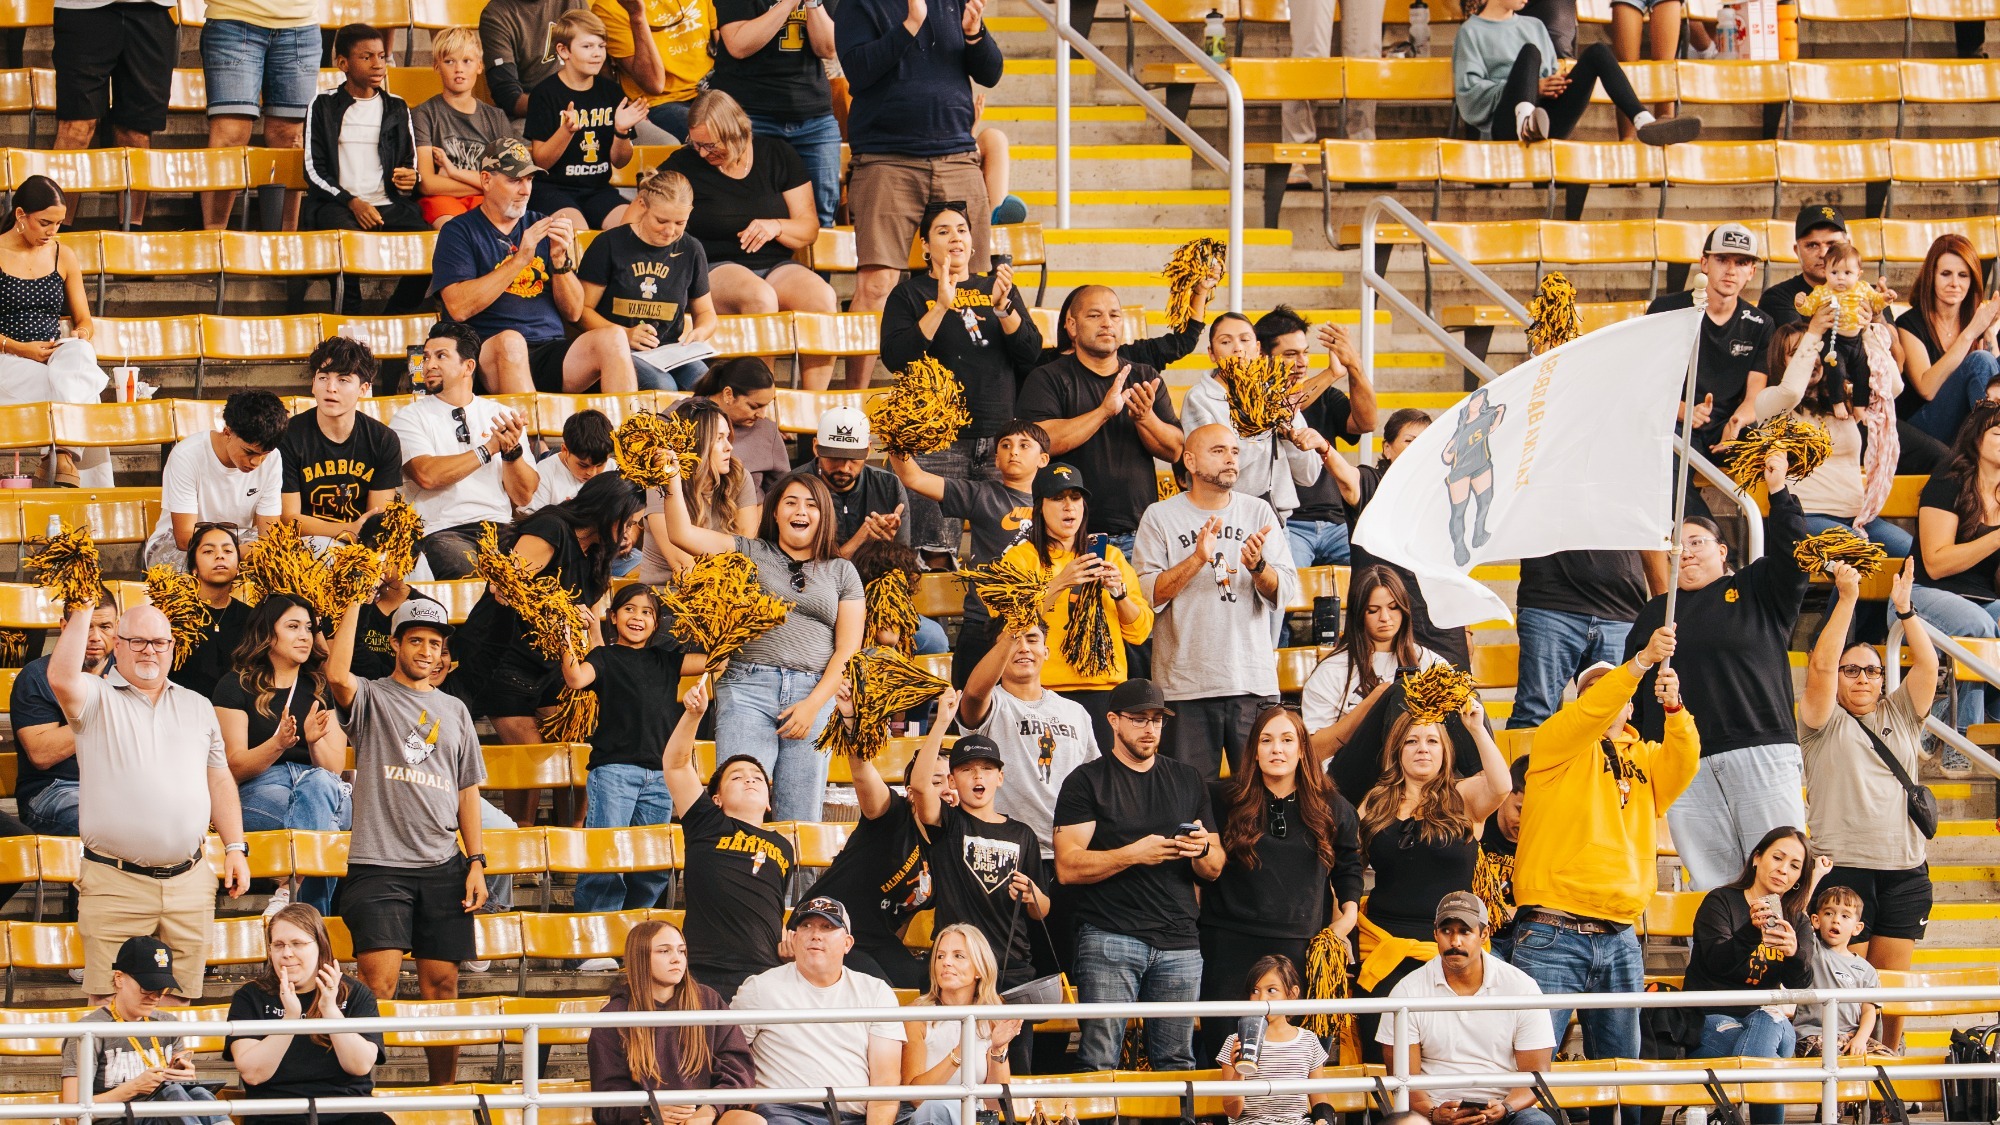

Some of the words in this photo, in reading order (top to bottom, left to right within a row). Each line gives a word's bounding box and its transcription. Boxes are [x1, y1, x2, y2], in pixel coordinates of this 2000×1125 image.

[565, 162, 609, 176] SOCCER
[631, 261, 670, 279] IDAHO
[628, 302, 662, 317] VANDALS
[828, 434, 860, 444] REIGN
[1010, 506, 1034, 519] NIK
[1178, 526, 1253, 549] BAOS
[1016, 719, 1079, 740] ARBOSA
[384, 764, 452, 793] VANDALS
[974, 853, 994, 864] THE
[880, 869, 907, 893] KALINA
[901, 844, 920, 874] BARBO
